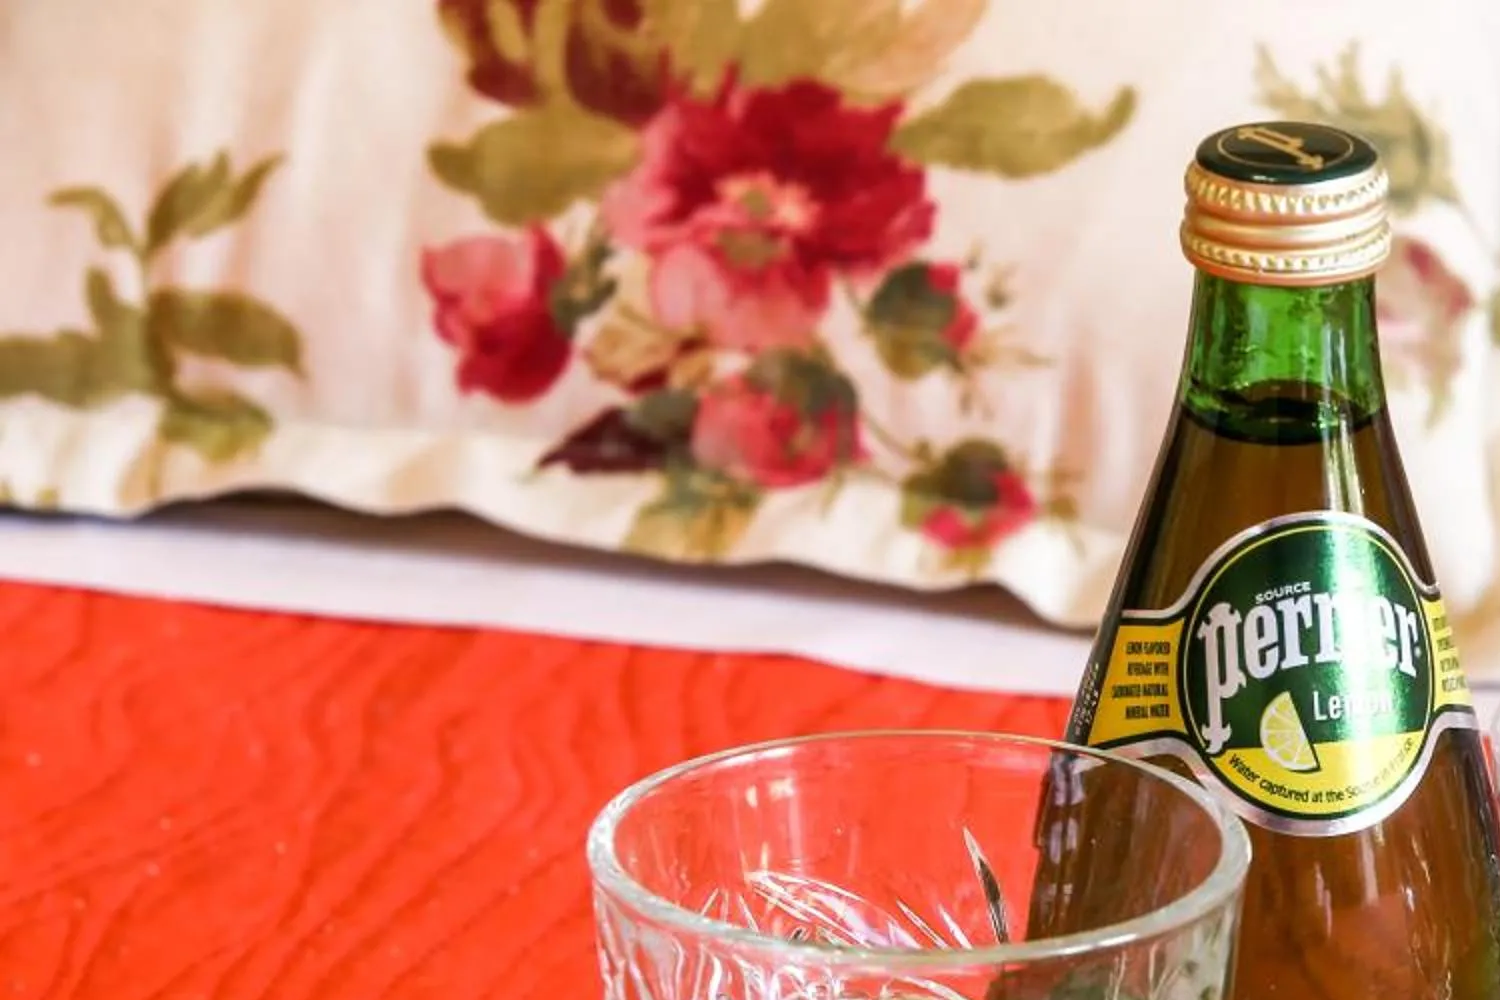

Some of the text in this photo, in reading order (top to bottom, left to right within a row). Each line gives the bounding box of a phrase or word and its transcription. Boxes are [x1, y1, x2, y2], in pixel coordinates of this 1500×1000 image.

[1255, 581, 1312, 604] SOURCE
[1229, 753, 1260, 782] Water
[1259, 778, 1309, 804] captured
[1311, 790, 1324, 803] at
[1325, 789, 1345, 802] the
